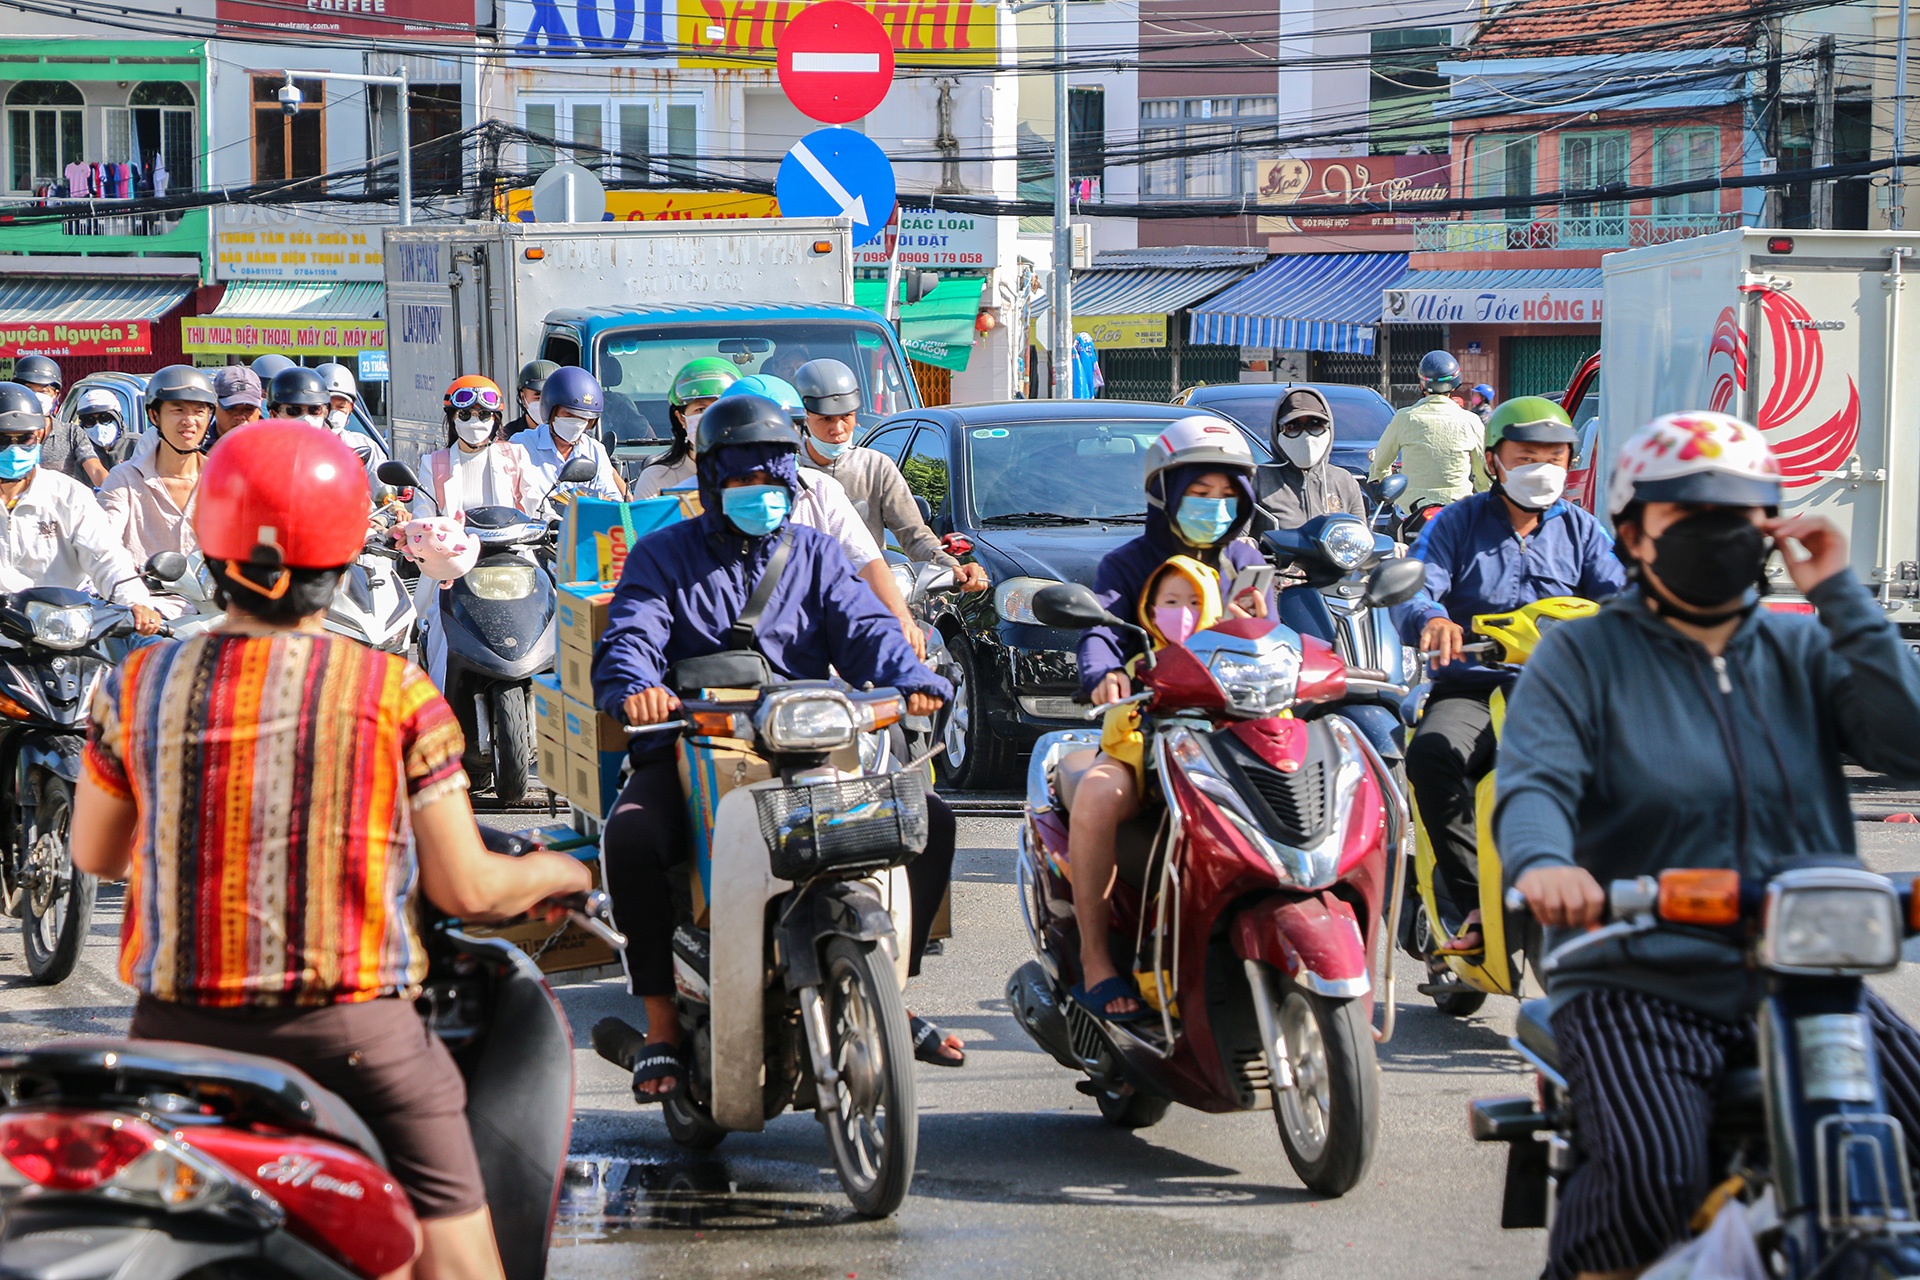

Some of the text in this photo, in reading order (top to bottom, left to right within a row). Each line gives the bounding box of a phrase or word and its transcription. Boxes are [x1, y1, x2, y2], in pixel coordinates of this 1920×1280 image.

[306, 0, 385, 13] COFFEE
[902, 217, 975, 232] CÁC LOẠI
[220, 229, 367, 244] TRUNG TÂM SỬA CHỮA VÀ
[917, 233, 949, 248] ĐẶT
[219, 249, 242, 263] BẢO
[247, 250, 277, 264] HÀNH
[899, 253, 929, 263] 0909
[934, 253, 956, 263] 179
[960, 253, 982, 263] 058
[1411, 294, 1465, 321] Uốn
[1475, 294, 1521, 321] Tóc
[1523, 292, 1584, 321] HỒNG
[402, 304, 442, 345] LAUNDRY
[1790, 319, 1846, 330] THACO
[0, 323, 139, 347] guyên Nguyên 3
[187, 327, 205, 344] THU
[208, 327, 232, 344] MUA
[236, 325, 258, 347] ĐIỆN
[262, 328, 294, 348] THOẠI,
[297, 326, 320, 346] MÁY
[324, 326, 340, 347] CŨ,
[343, 326, 367, 347] MÁY
[1092, 324, 1122, 342] Lee
[16, 347, 42, 356] Chuyên
[920, 343, 948, 356] NGON
[362, 359, 388, 373] 23 THÁN
